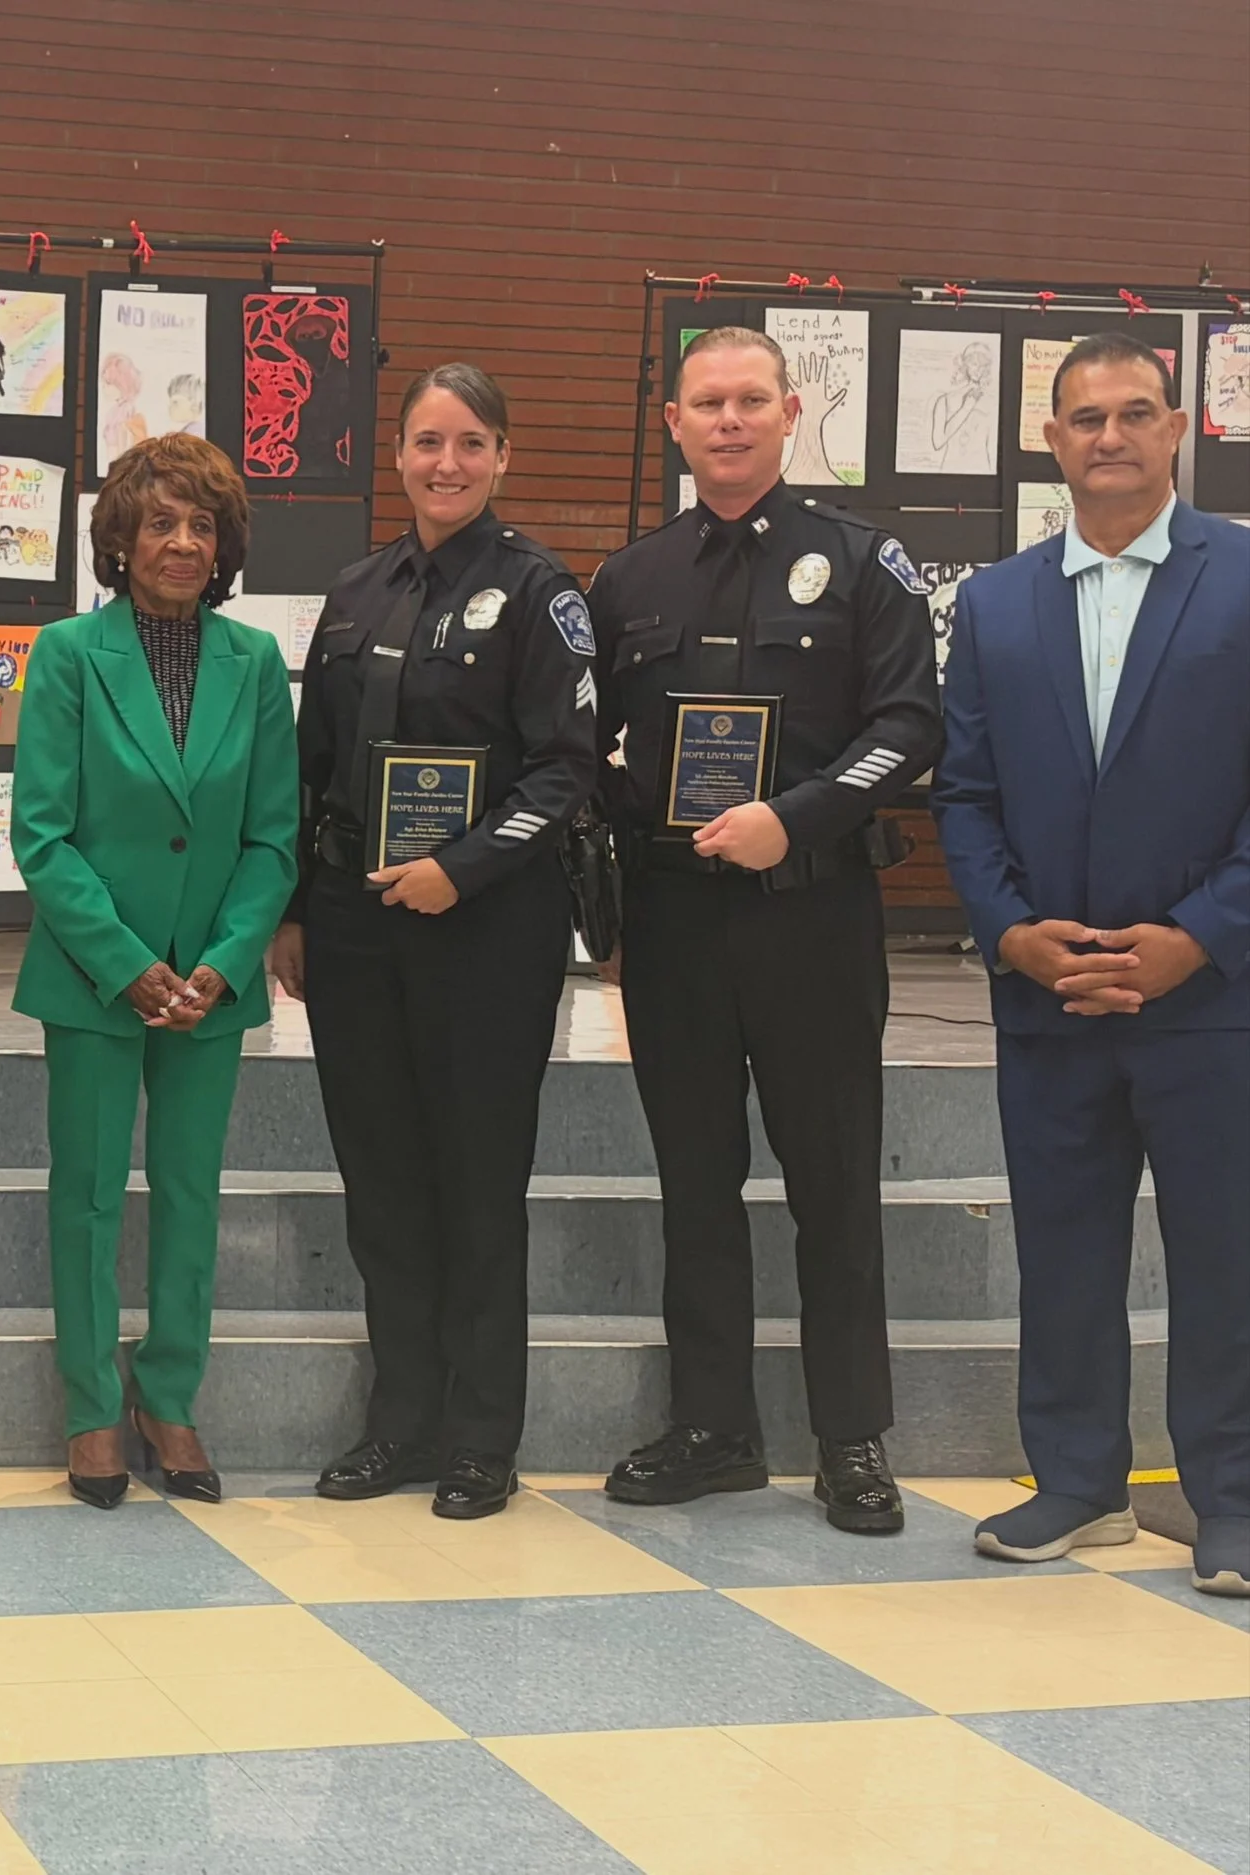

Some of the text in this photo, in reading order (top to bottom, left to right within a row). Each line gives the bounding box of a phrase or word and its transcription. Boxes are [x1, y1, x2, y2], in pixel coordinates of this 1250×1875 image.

[117, 304, 145, 328] NO
[777, 312, 842, 329] Lend A
[776, 329, 806, 342] Hand
[1026, 343, 1043, 361] No
[14, 467, 44, 481] AND
[922, 563, 968, 596] STOP
[682, 751, 756, 761] HOPE LIVES HERE
[390, 804, 465, 814] HOPE LIVES HERE
